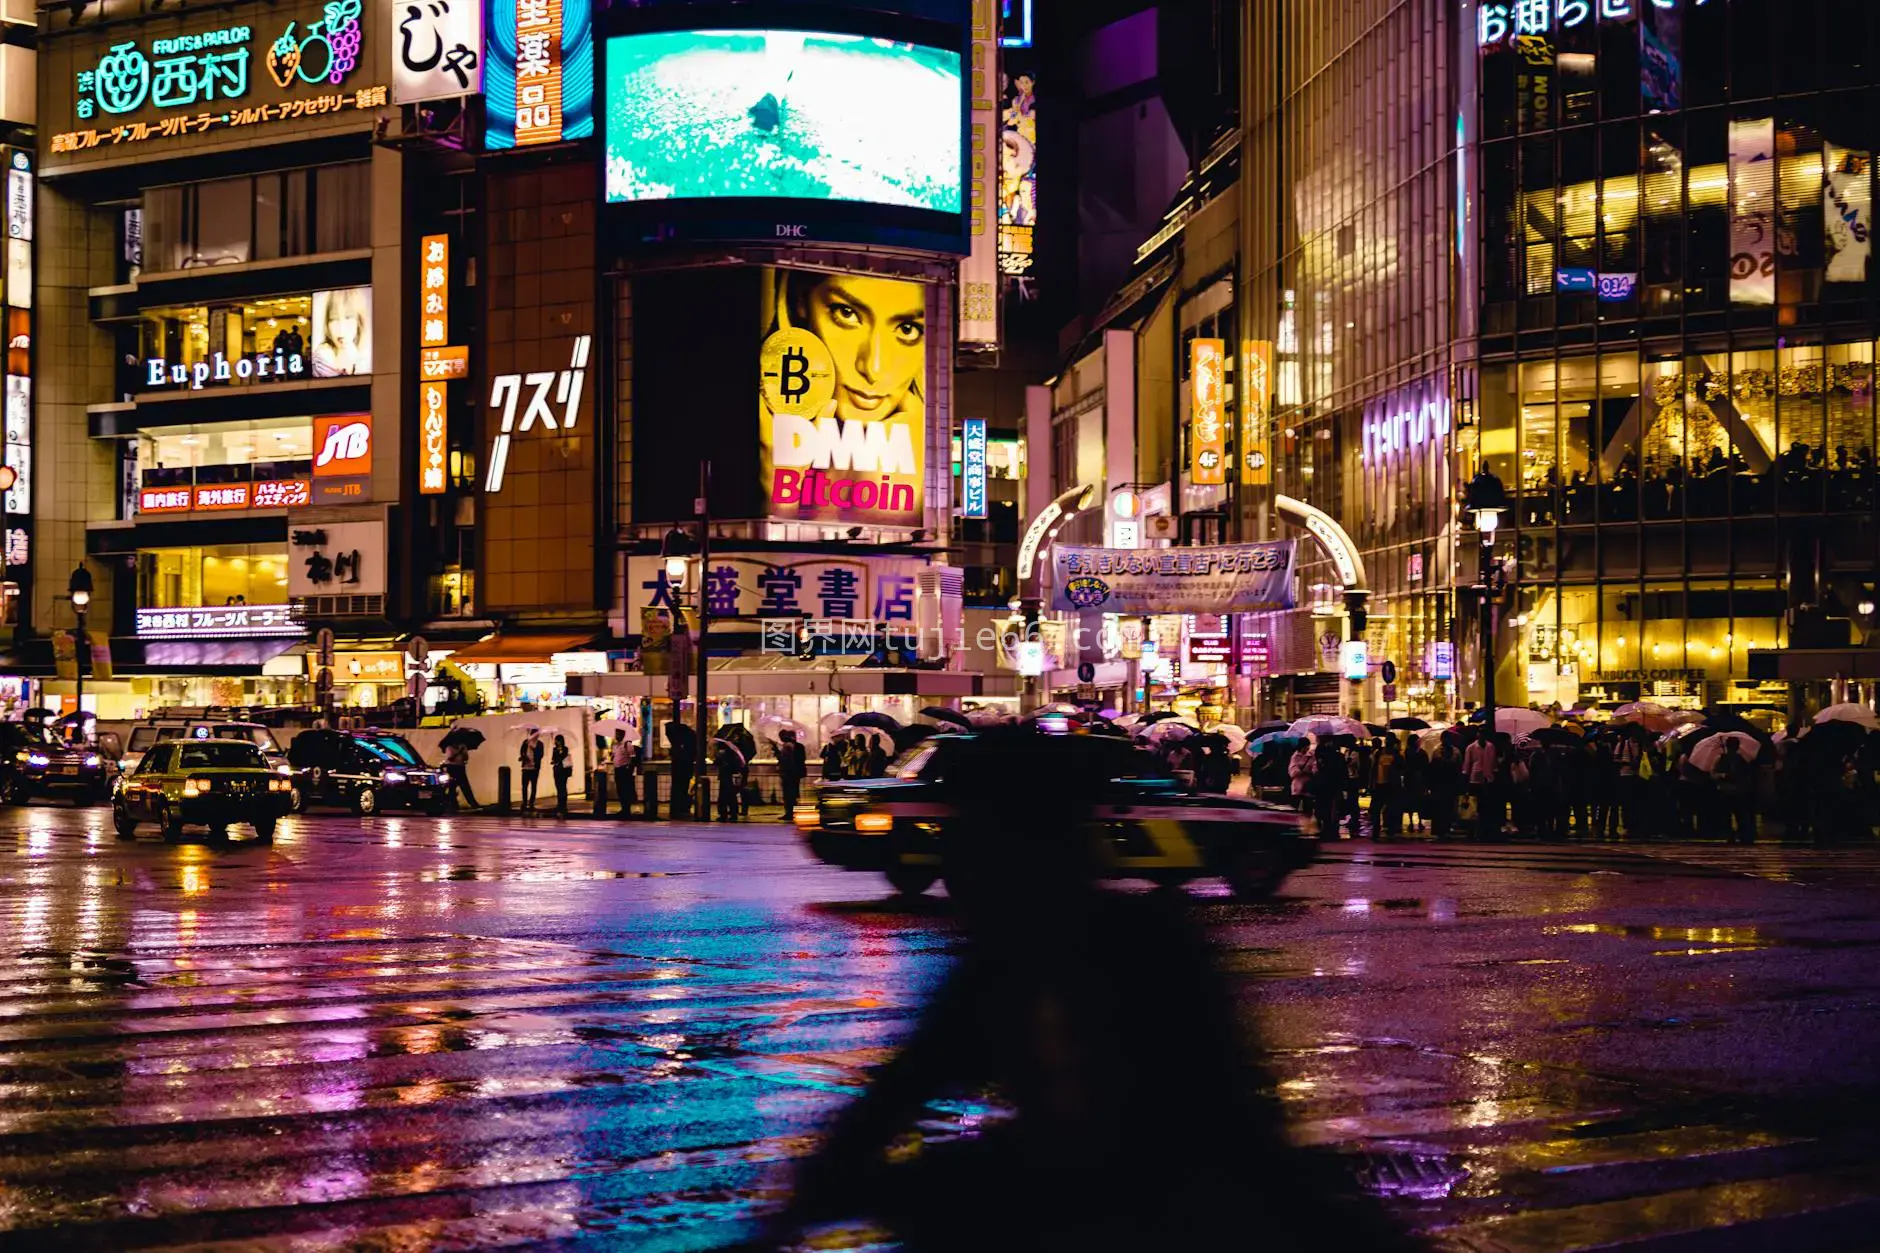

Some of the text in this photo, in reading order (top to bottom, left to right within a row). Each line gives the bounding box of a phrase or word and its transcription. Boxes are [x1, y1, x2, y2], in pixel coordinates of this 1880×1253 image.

[77, 71, 94, 118] 渋谷
[152, 47, 249, 107] 西村
[776, 224, 807, 237] DHC
[147, 347, 304, 389] Euphoria
[316, 422, 370, 467] JTB
[772, 413, 916, 475] DMM
[143, 491, 190, 508] 国内旅行
[197, 488, 247, 505] 海外旅行
[258, 481, 304, 495] ハネムーン
[771, 468, 915, 511] Bitcoin
[642, 565, 916, 620] 大盛堂書店
[1650, 668, 1706, 681] COFFEE
